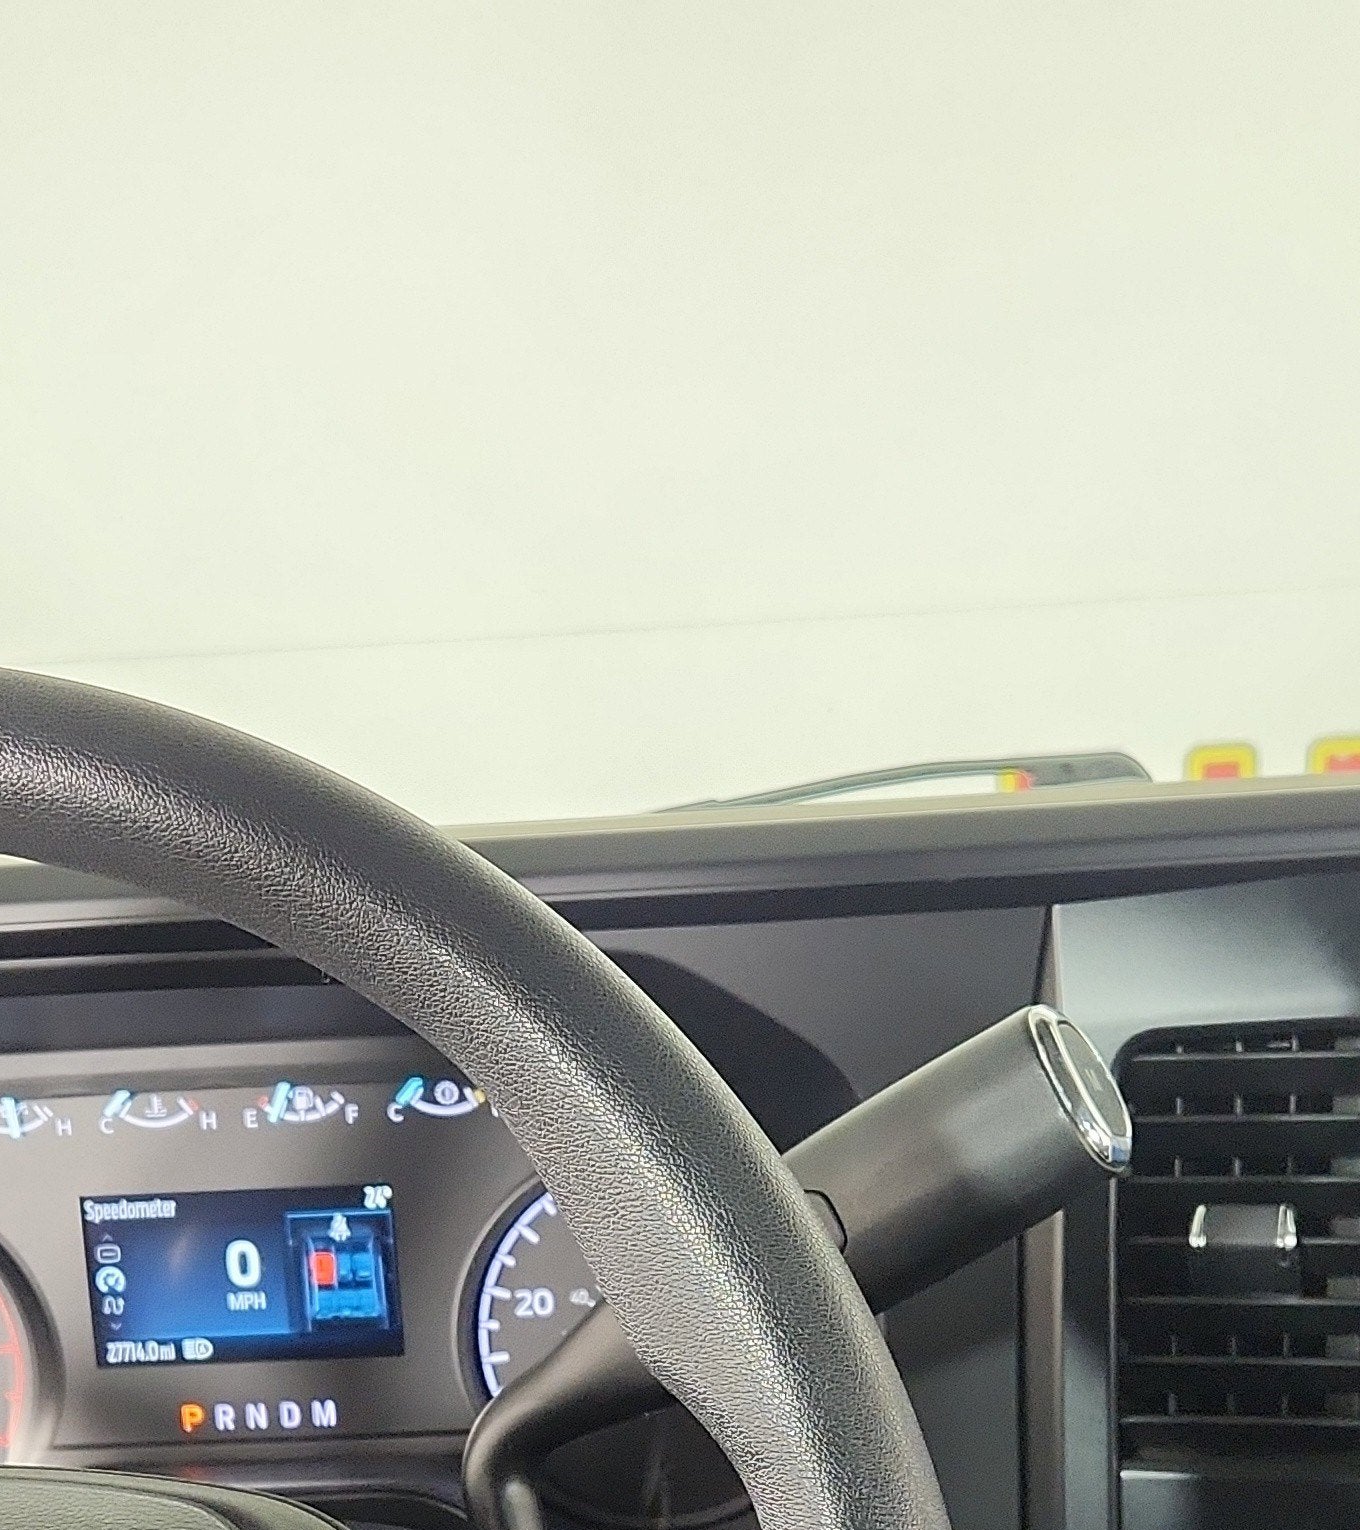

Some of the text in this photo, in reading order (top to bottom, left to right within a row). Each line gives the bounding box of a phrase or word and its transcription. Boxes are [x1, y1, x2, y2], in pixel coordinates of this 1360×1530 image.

[199, 1110, 218, 1131] H
[243, 1107, 258, 1128] E
[344, 1103, 359, 1125] F
[55, 1117, 73, 1137] H
[99, 1118, 114, 1135] C
[83, 1198, 177, 1223] Speedometer
[225, 1239, 261, 1289] 0
[226, 1291, 267, 1312] MPH
[513, 1287, 555, 1318] 20
[180, 1399, 337, 1432] P R N D M
